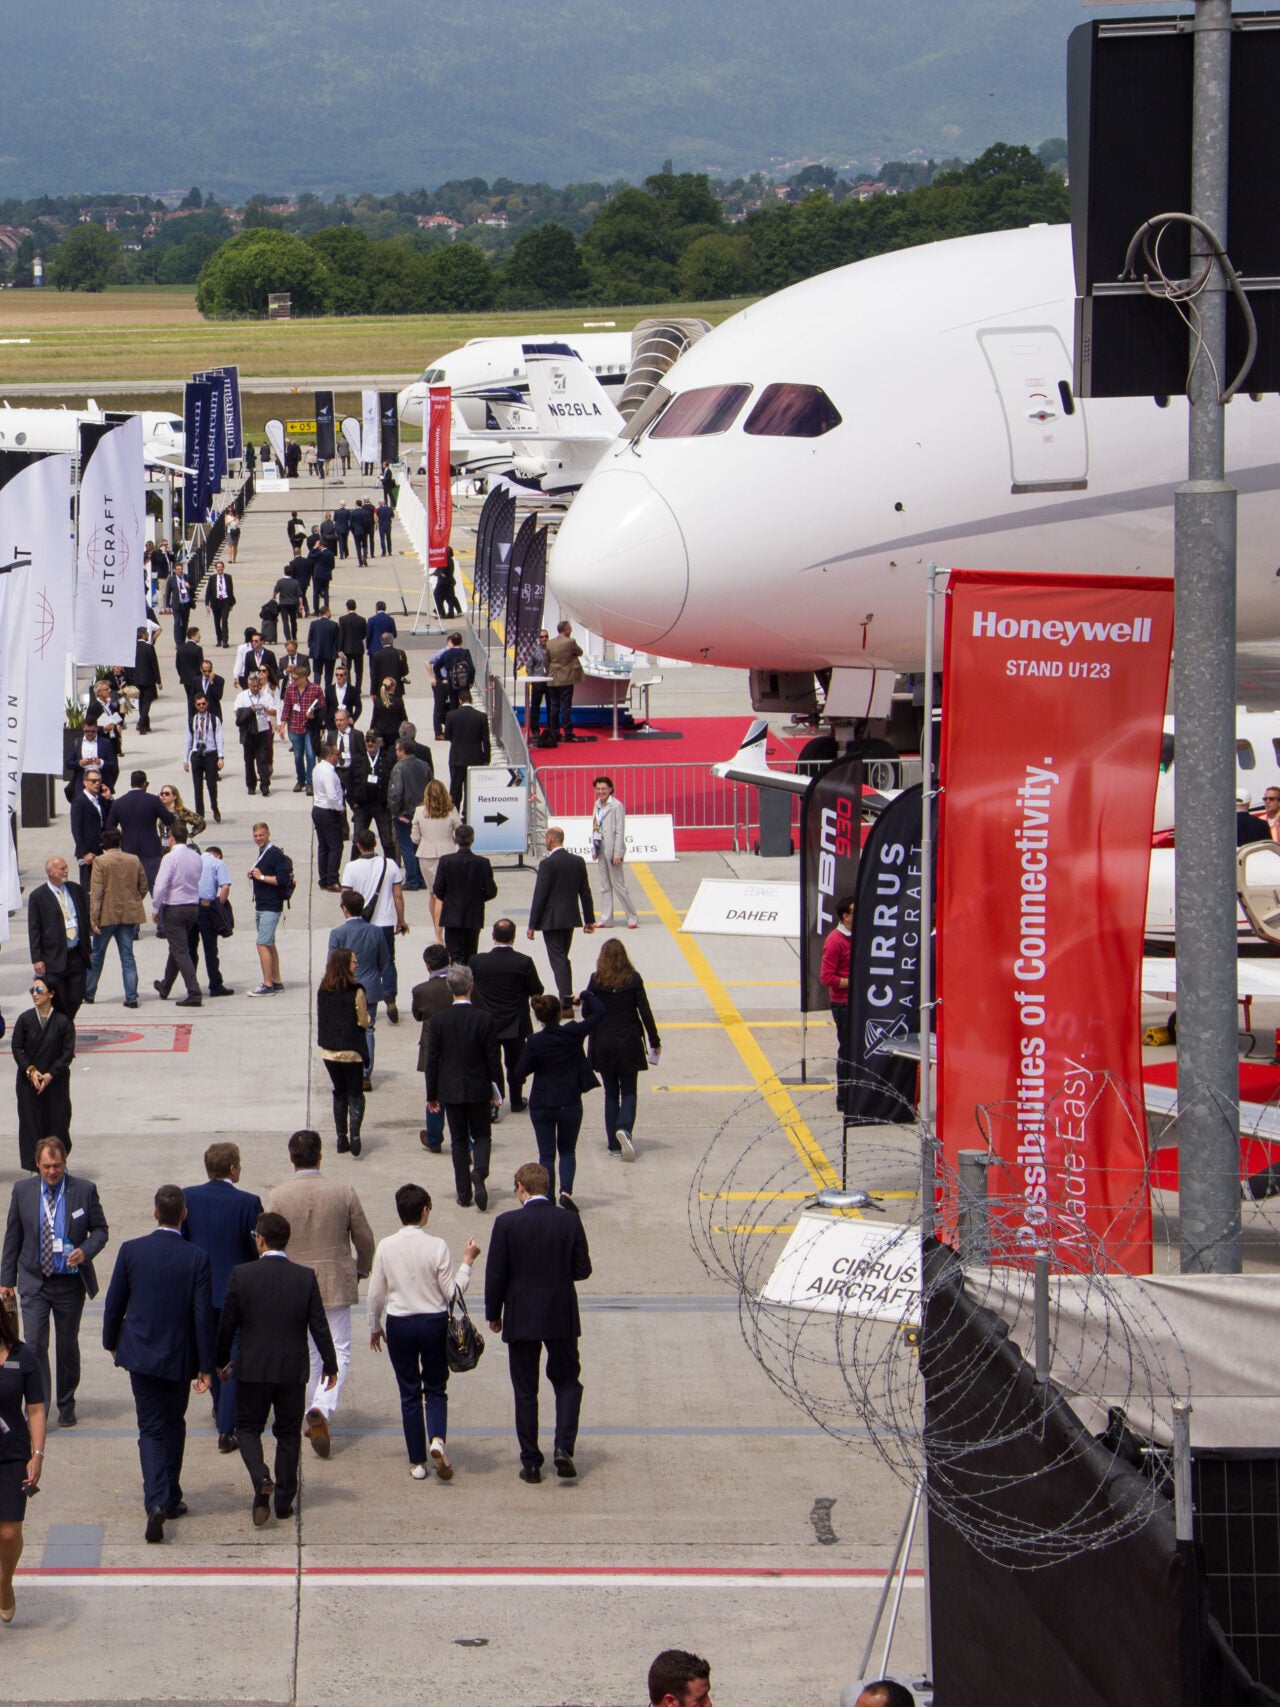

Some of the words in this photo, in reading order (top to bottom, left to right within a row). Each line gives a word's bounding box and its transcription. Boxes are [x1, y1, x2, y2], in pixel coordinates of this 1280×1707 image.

[206, 390, 218, 481] Gulfstream
[224, 378, 235, 449] Gulfstream
[548, 402, 602, 416] N626LA
[101, 494, 116, 608] JETCRAFT
[972, 611, 1152, 646] Honeywell
[1006, 659, 1063, 677] STAND
[1069, 662, 1111, 679] U123
[477, 795, 519, 803] Restrooms
[836, 797, 852, 859] 930
[629, 845, 658, 854] JETS
[817, 807, 838, 935] TBM
[1014, 757, 1059, 981] Connectivity.
[726, 909, 779, 922] DAHER
[867, 842, 905, 1007] CIRRUS
[899, 844, 923, 1008] AIRCRAFT
[1014, 991, 1046, 1026] of
[1056, 1053, 1094, 1142] Easy.
[1016, 1037, 1048, 1248] Possibilities
[1056, 1154, 1087, 1248] Made
[806, 1277, 921, 1305] AIRCRAFT
[832, 1257, 917, 1283] CIRRUS
